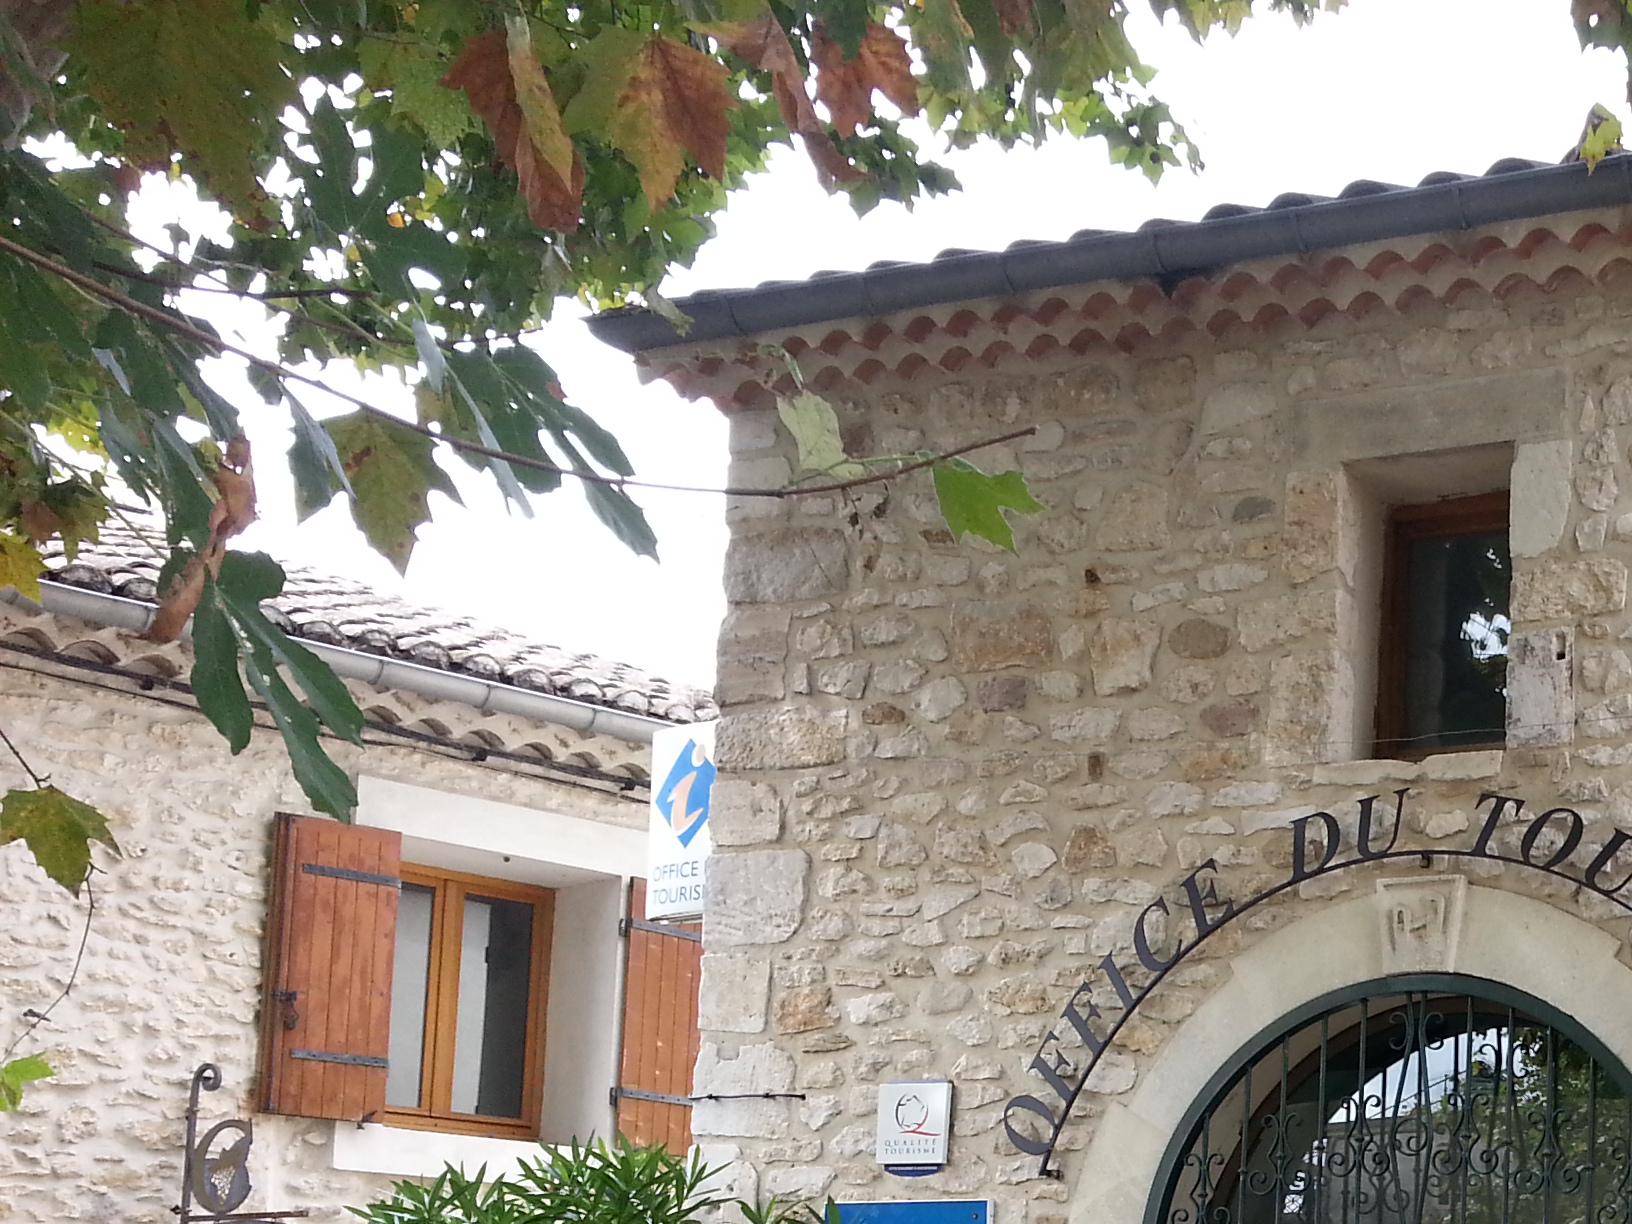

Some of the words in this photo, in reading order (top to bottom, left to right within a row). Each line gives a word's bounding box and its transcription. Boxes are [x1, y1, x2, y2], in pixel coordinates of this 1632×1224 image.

[652, 861, 699, 882] OFFICE
[1003, 858, 1239, 1157] OFFICE
[1288, 787, 1411, 884] DU
[884, 1147, 936, 1155] TOURISME
